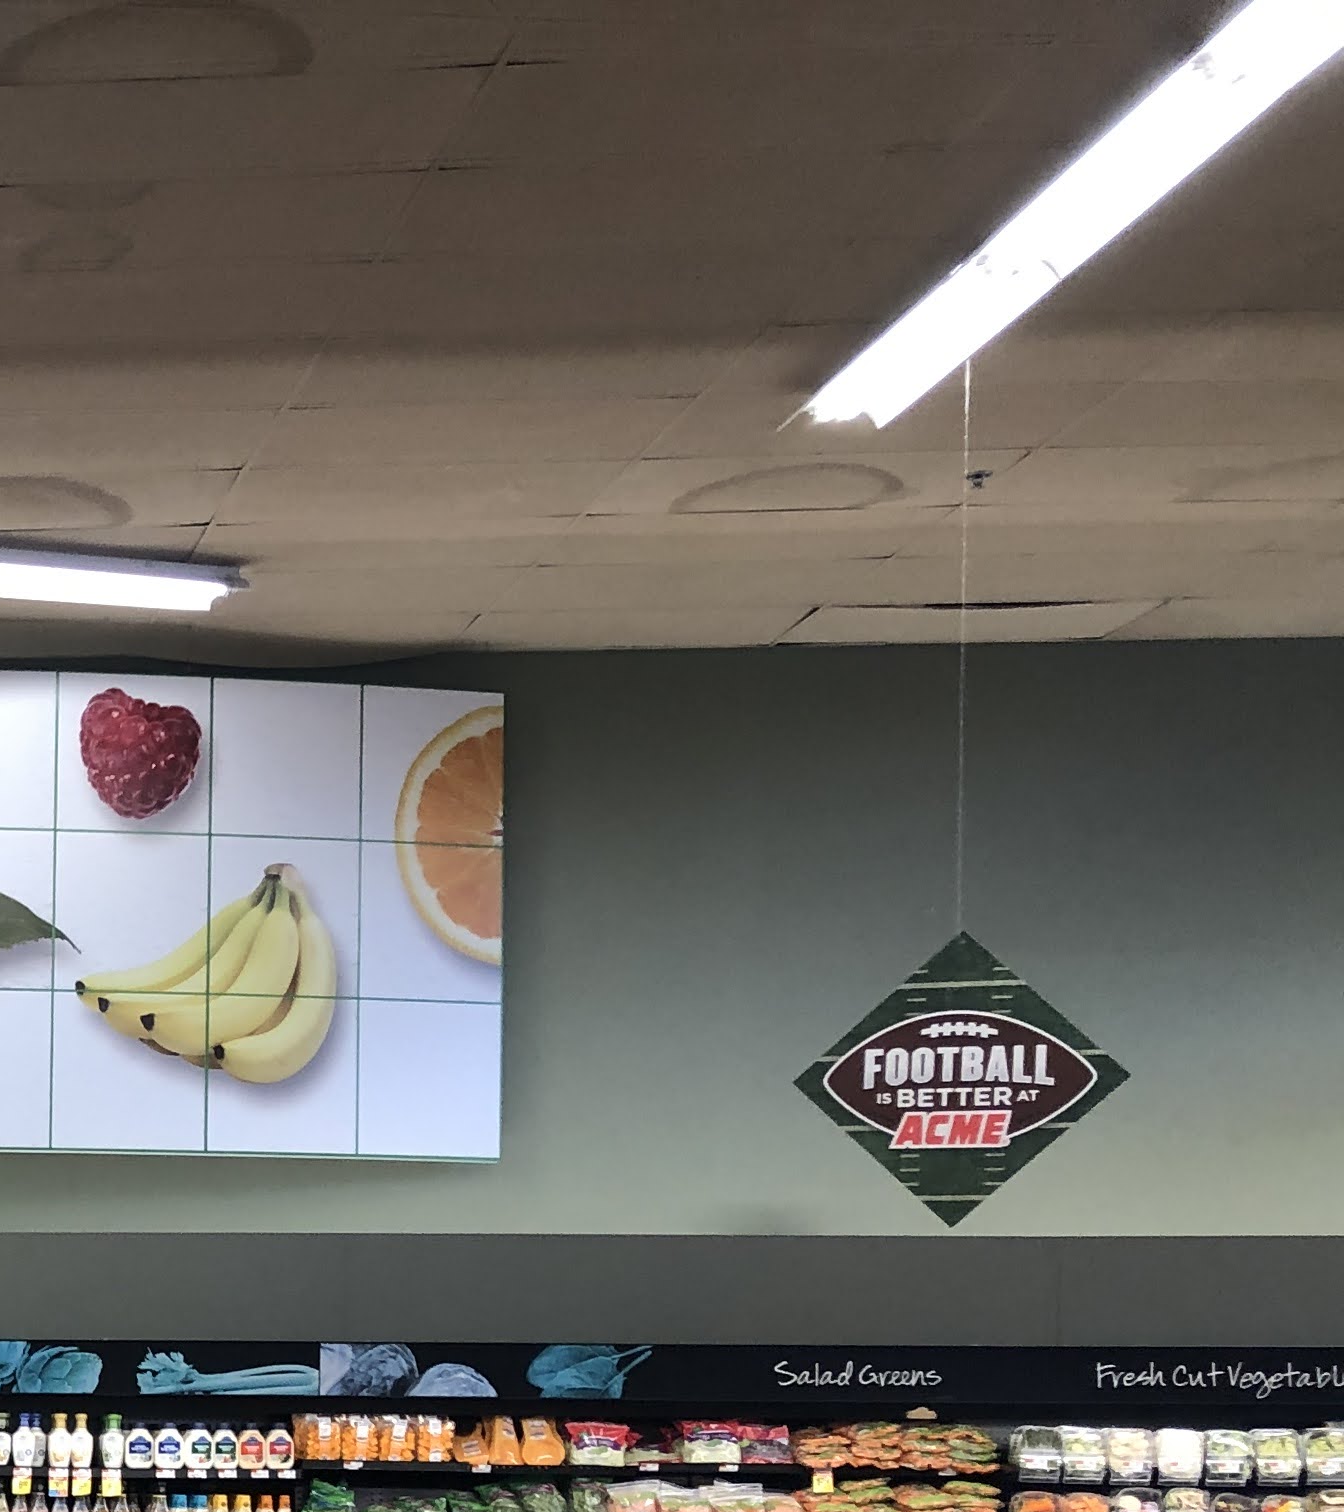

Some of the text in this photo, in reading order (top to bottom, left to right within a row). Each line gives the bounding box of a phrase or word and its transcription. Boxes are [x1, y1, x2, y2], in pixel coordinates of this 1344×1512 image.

[862, 1044, 1055, 1090] FOOTBALL
[876, 1087, 1040, 1108] IS BETTER AT
[894, 1112, 1008, 1146] ACME
[774, 1360, 942, 1387] Salad Greens
[1096, 1361, 1344, 1399] Fresh Cut Vegetabl
